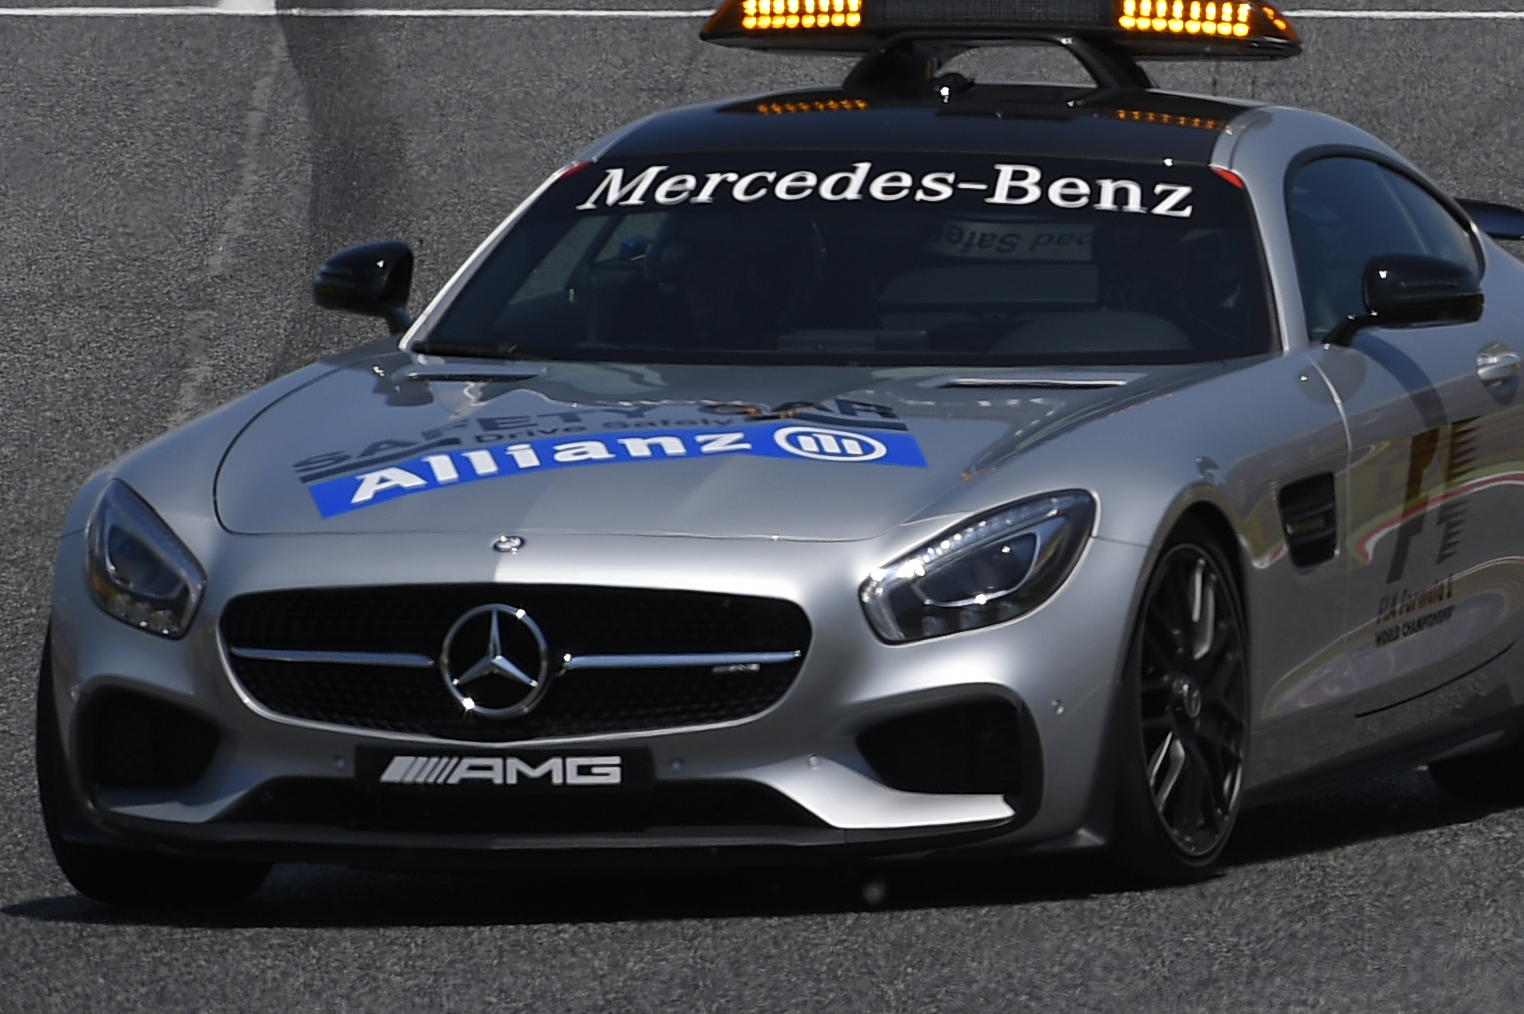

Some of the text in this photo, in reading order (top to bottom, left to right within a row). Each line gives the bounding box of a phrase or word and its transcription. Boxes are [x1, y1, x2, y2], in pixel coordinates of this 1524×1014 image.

[576, 162, 1194, 218] Mercedes-Benz
[474, 426, 588, 443] Drive
[350, 431, 753, 503] Allianz
